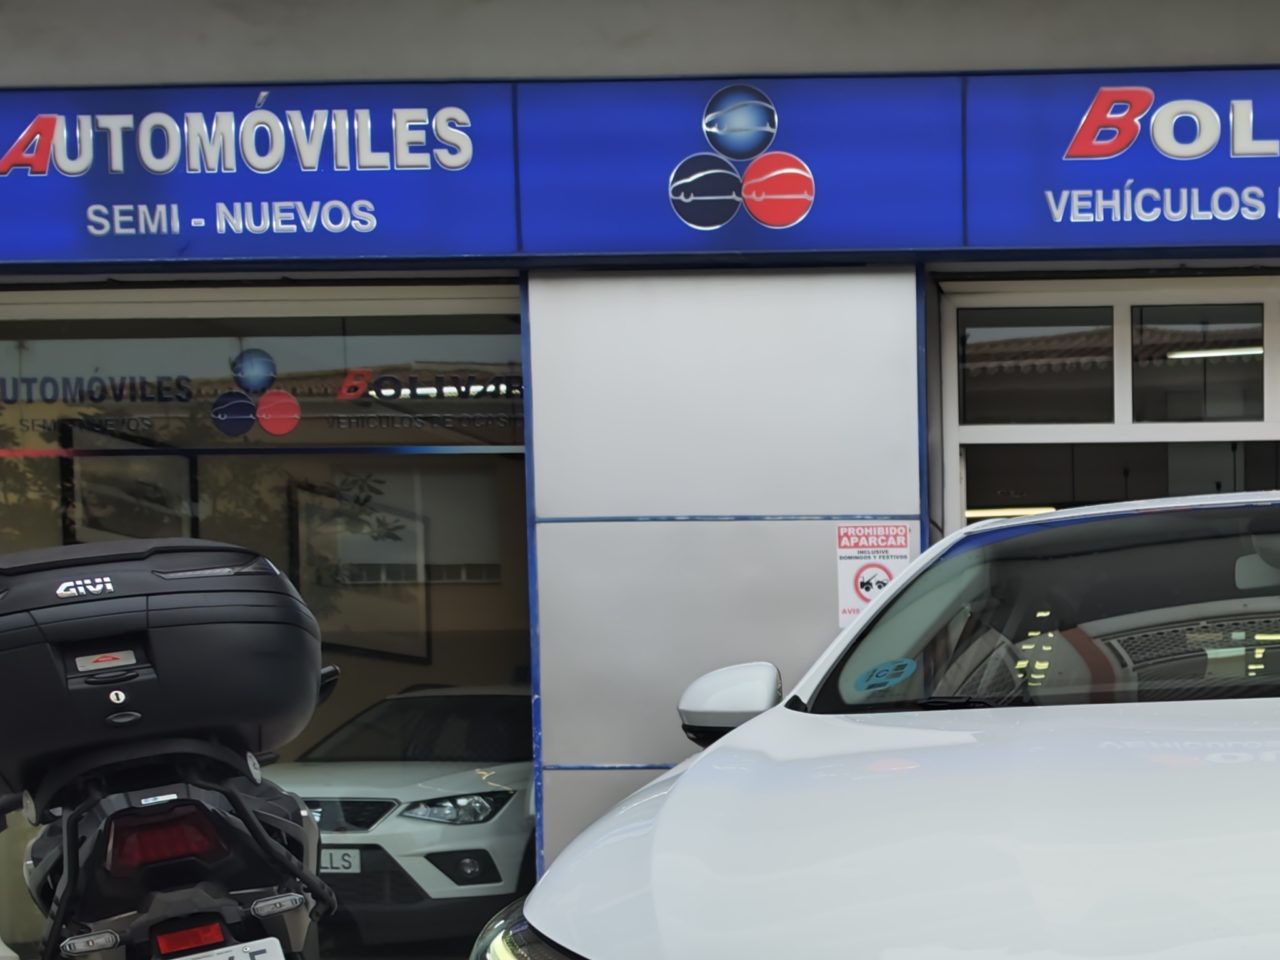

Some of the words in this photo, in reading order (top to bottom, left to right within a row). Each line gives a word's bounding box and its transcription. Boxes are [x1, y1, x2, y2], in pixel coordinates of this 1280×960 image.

[0, 91, 474, 177] AUTOMÓVILES
[86, 204, 180, 236] SEMI
[216, 200, 377, 234] NUEVOS
[1045, 179, 1266, 222] VEHÍCULOS
[0, 367, 193, 404] UTOMÓVILES
[840, 527, 906, 536] PROHIBIDO
[840, 536, 906, 547] APARCAR
[56, 577, 114, 598] GIVI
